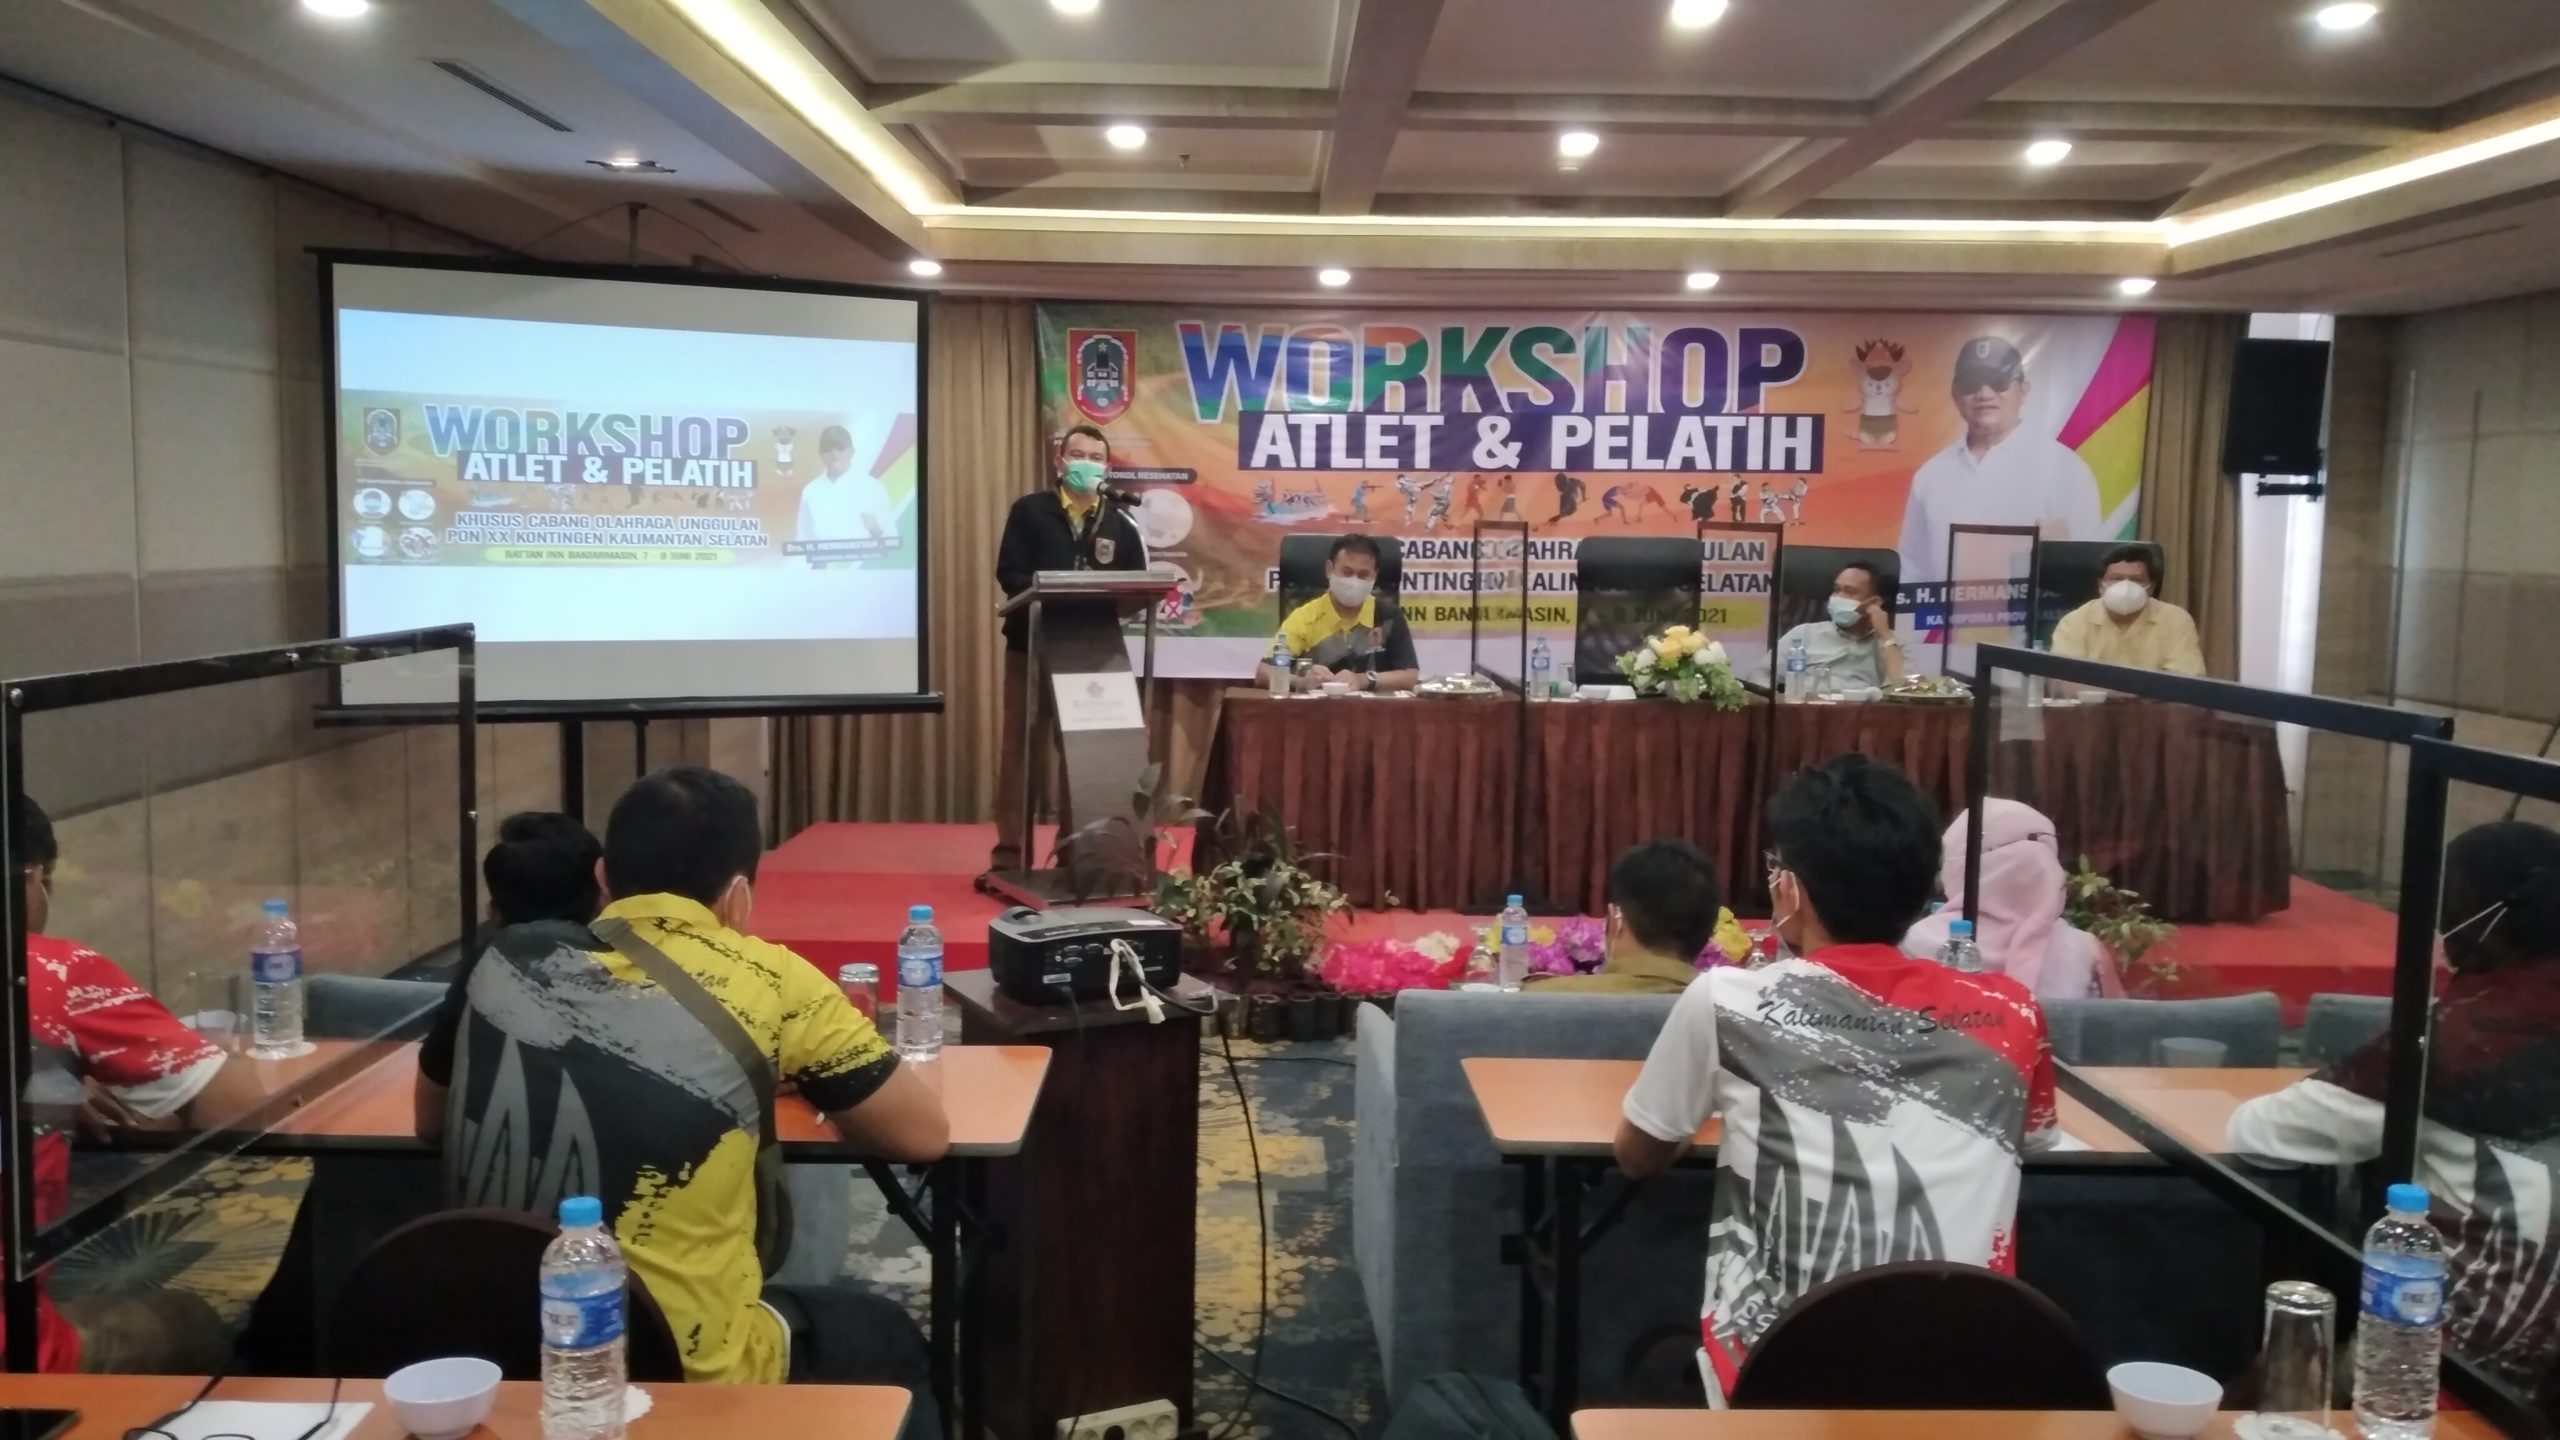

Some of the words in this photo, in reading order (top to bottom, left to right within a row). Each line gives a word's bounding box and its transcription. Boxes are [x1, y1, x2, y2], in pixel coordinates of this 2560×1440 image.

[1176, 321, 1805, 423] WORKSHOP
[425, 404, 749, 460] WORKSHOP
[1250, 414, 1444, 469] ATLET
[1471, 416, 1522, 470] &
[1551, 415, 1813, 471] PELATIH
[464, 452, 568, 484] ATLET
[582, 457, 608, 485] &
[623, 457, 753, 488] PELATIH
[447, 530, 479, 543] PON
[487, 530, 510, 544] XX
[516, 530, 604, 545] KONTINGEN
[609, 531, 703, 546] KALIMANTAN
[708, 532, 769, 547] SELATAN
[457, 513, 522, 528] KHUSUS
[528, 514, 590, 530] CABANG
[595, 515, 674, 530] OLAHRAGA
[680, 517, 760, 532] UNGGULAN
[1916, 588, 1936, 604] H.
[1757, 1000, 1904, 1036] Kalimantan
[1917, 1004, 2007, 1034] Selatan
